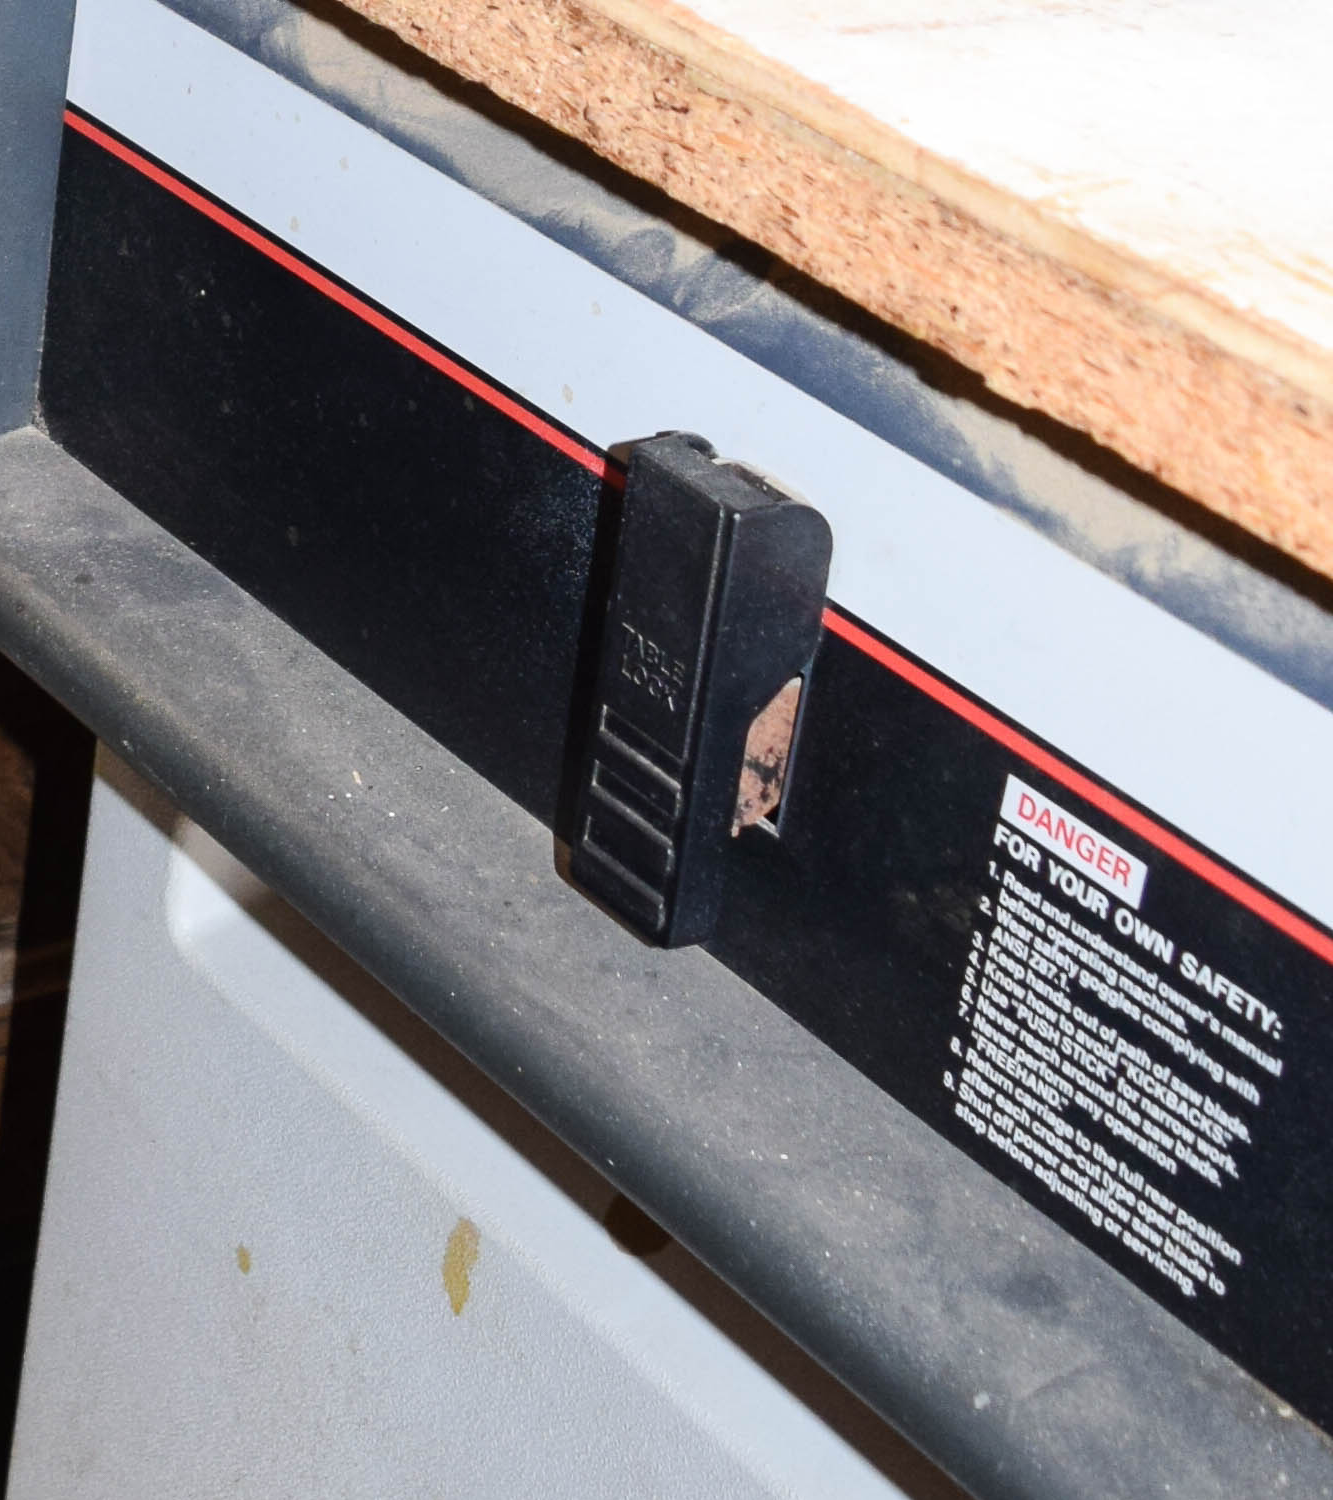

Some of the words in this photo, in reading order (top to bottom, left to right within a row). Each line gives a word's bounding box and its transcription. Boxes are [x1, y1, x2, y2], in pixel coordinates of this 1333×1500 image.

[621, 621, 686, 688] TABLE
[621, 652, 676, 712] LOCK
[994, 823, 1040, 871] FOR
[1049, 859, 1108, 918] YOUR
[1115, 908, 1173, 963] OWN
[1180, 952, 1281, 1038] SAFETY:
[1018, 794, 1129, 884] DANGER
[969, 950, 979, 968] 4.
[984, 960, 1025, 998] Know
[1026, 990, 1057, 1022] how
[1059, 1014, 1073, 1035] to
[1075, 1029, 1119, 1067] avoid
[972, 931, 983, 950] 3.
[988, 942, 1024, 979] Keep
[1026, 969, 1071, 1012] hands
[1073, 1006, 1098, 1032] out
[1099, 1025, 1116, 1043] of
[1115, 1037, 1150, 1070] path
[1152, 1064, 1170, 1082] of
[1170, 1076, 1202, 1105] saw
[1203, 1096, 1250, 1142] blade.
[979, 896, 991, 915] 2.
[997, 906, 1033, 945] Wear
[1031, 936, 1078, 977] safety
[1079, 969, 1140, 1020] goggles
[1142, 1014, 1223, 1081] complying
[1226, 1071, 1259, 1104] with
[989, 861, 998, 879] 1.
[1003, 870, 1041, 907] Read
[1041, 900, 1070, 928] and
[1071, 920, 1157, 989] understand
[1158, 982, 1219, 1033] owner's
[1221, 1025, 1281, 1075] manual
[992, 926, 1028, 960] ANSI
[999, 888, 1045, 931] before
[1046, 925, 1117, 985] operating
[1119, 975, 1187, 1033] machine.
[950, 1037, 961, 1055] 8.
[966, 1048, 1012, 1090] Return
[1014, 1088, 1073, 1138] carriage
[1075, 1130, 1090, 1151] to
[1093, 1143, 1116, 1170] the
[1119, 1162, 1143, 1191] full
[1145, 1184, 1175, 1213] rear
[1176, 1208, 1240, 1264] position
[959, 1001, 969, 1021] 7.
[972, 1013, 1015, 1054] Never
[1013, 1047, 1073, 1100] perform
[1074, 1091, 1102, 1120] any
[1104, 1113, 1176, 1173] operation
[961, 1068, 994, 1098] after
[995, 1094, 1029, 1124] each
[1032, 1121, 1101, 1180] cross-cut
[1102, 1171, 1135, 1205] type
[1137, 1200, 1212, 1266] operation.
[962, 984, 972, 1003] 6.
[977, 995, 1018, 1034] Never
[1020, 1029, 1059, 1066] reach
[1061, 1060, 1115, 1106] around
[1116, 1098, 1140, 1125] the
[1142, 1119, 1173, 1148] saw
[1175, 1139, 1220, 1186] blade.
[965, 966, 976, 985] 5.
[981, 977, 1008, 1007] Use
[1117, 1077, 1139, 1102] for
[1141, 1097, 1195, 1143] narrow
[1197, 1137, 1238, 1177] work.
[944, 1071, 954, 1090] 9.
[958, 1082, 991, 1118] Shut
[992, 1112, 1013, 1133] off
[1013, 1127, 1059, 1167] power
[1060, 1163, 1089, 1191] and
[1089, 1185, 1130, 1221] allow
[1131, 1216, 1162, 1246] saw
[1164, 1237, 1206, 1280] blade
[1209, 1272, 1224, 1294] to
[955, 1103, 985, 1133] stop
[987, 1124, 1032, 1169] before
[1034, 1163, 1102, 1226] adjusting
[1104, 1217, 1121, 1235] or
[1123, 1231, 1195, 1295] servicing.
